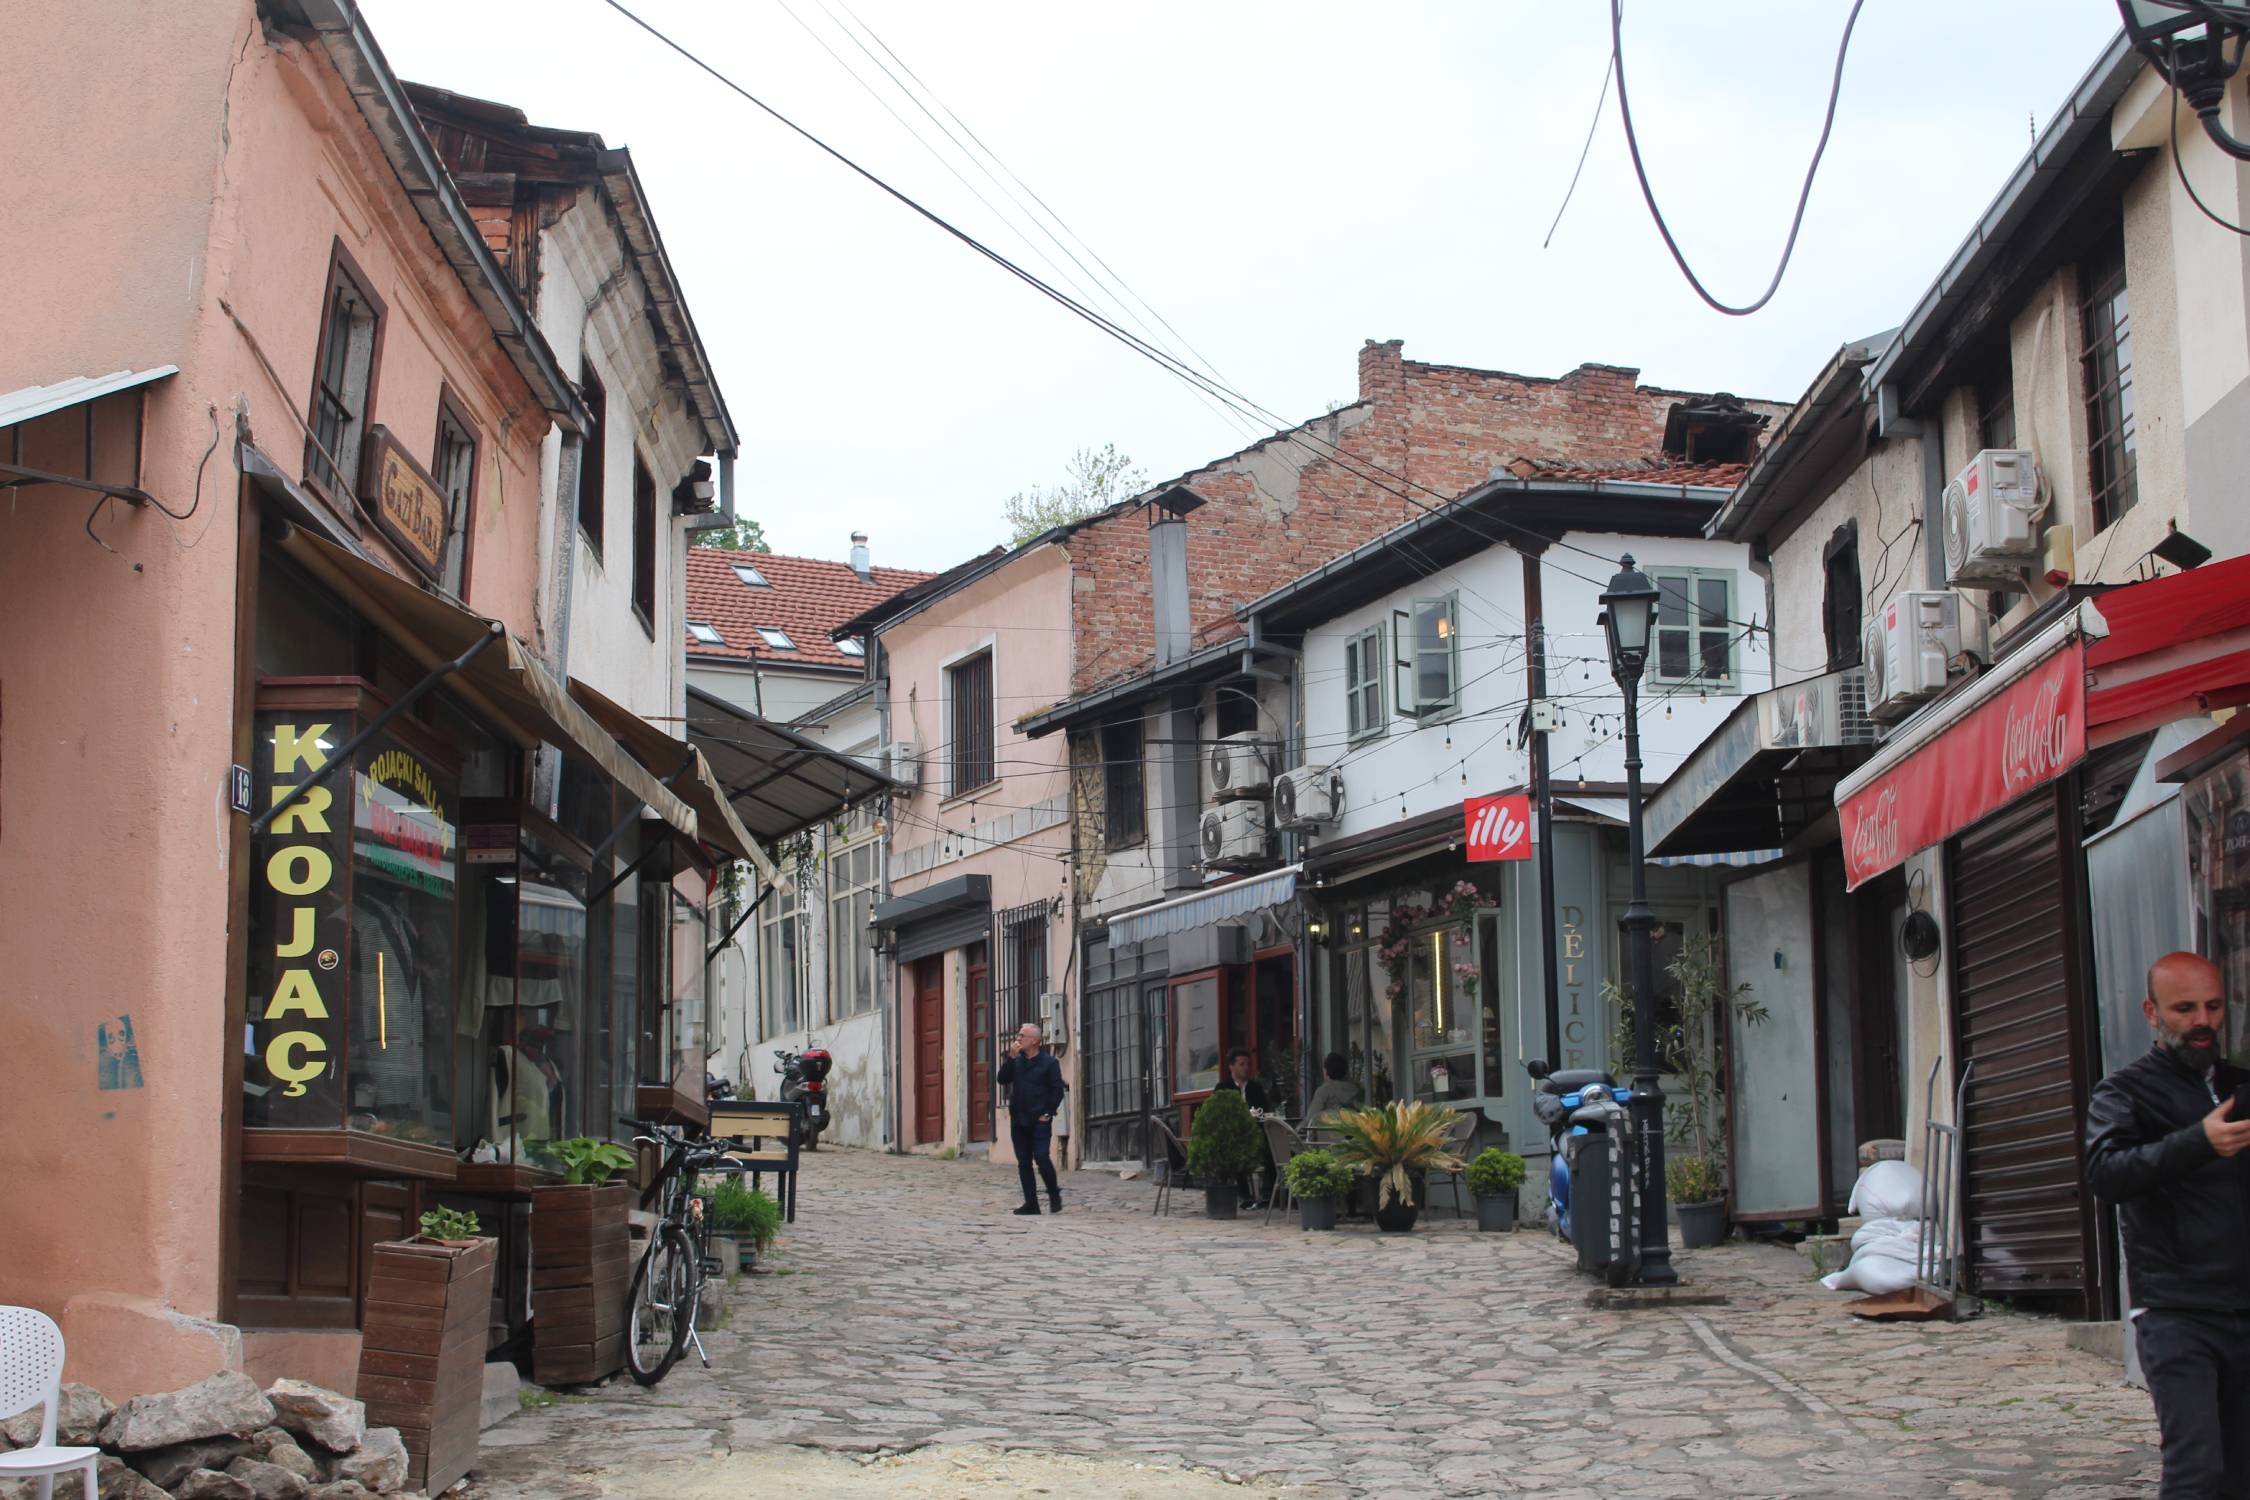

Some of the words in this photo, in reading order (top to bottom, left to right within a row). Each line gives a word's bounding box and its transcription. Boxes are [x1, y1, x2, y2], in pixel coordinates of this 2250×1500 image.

[264, 724, 333, 1097] KROJAÇ
[1469, 806, 1525, 854] illy
[1562, 906, 1586, 1070] DÉLICE
